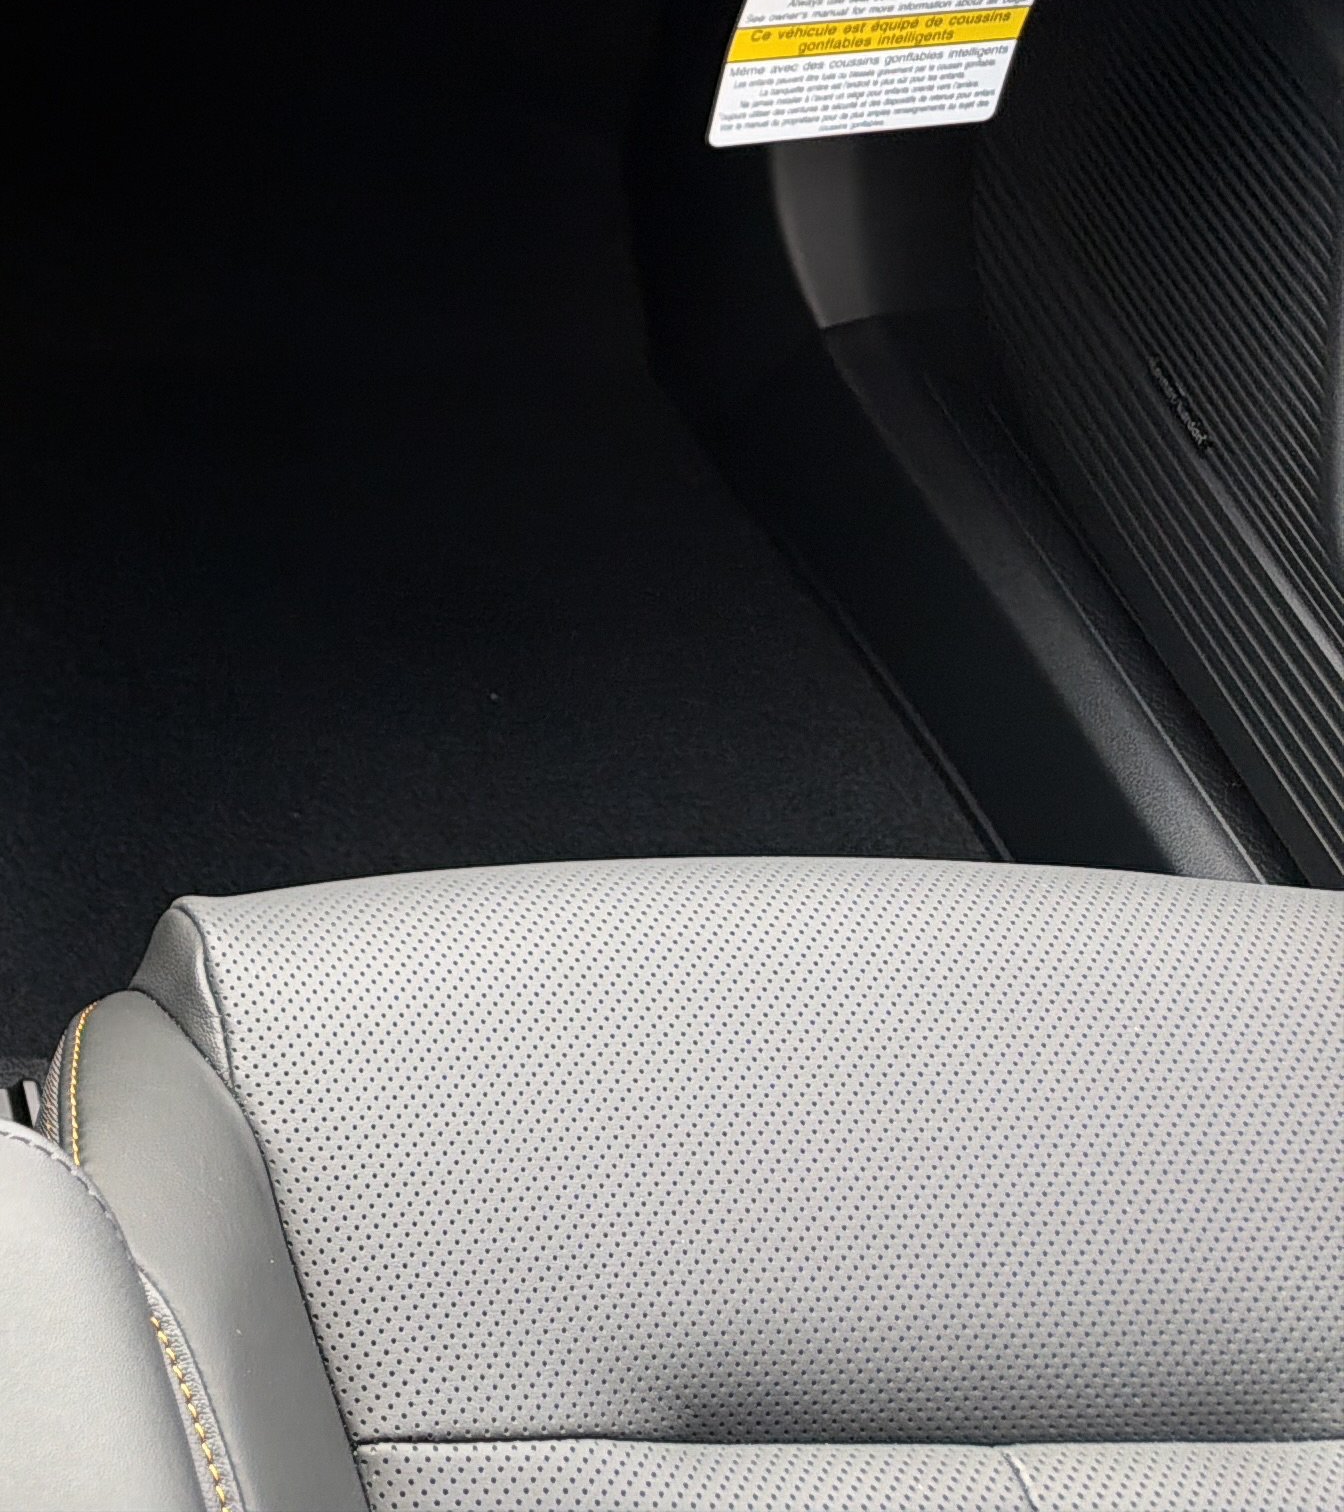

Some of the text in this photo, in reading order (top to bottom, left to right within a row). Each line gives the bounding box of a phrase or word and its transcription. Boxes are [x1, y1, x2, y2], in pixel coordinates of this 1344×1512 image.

[751, 11, 1011, 42] Ce véhicule est équipé de coussins
[798, 29, 955, 53] gonflables intelligents
